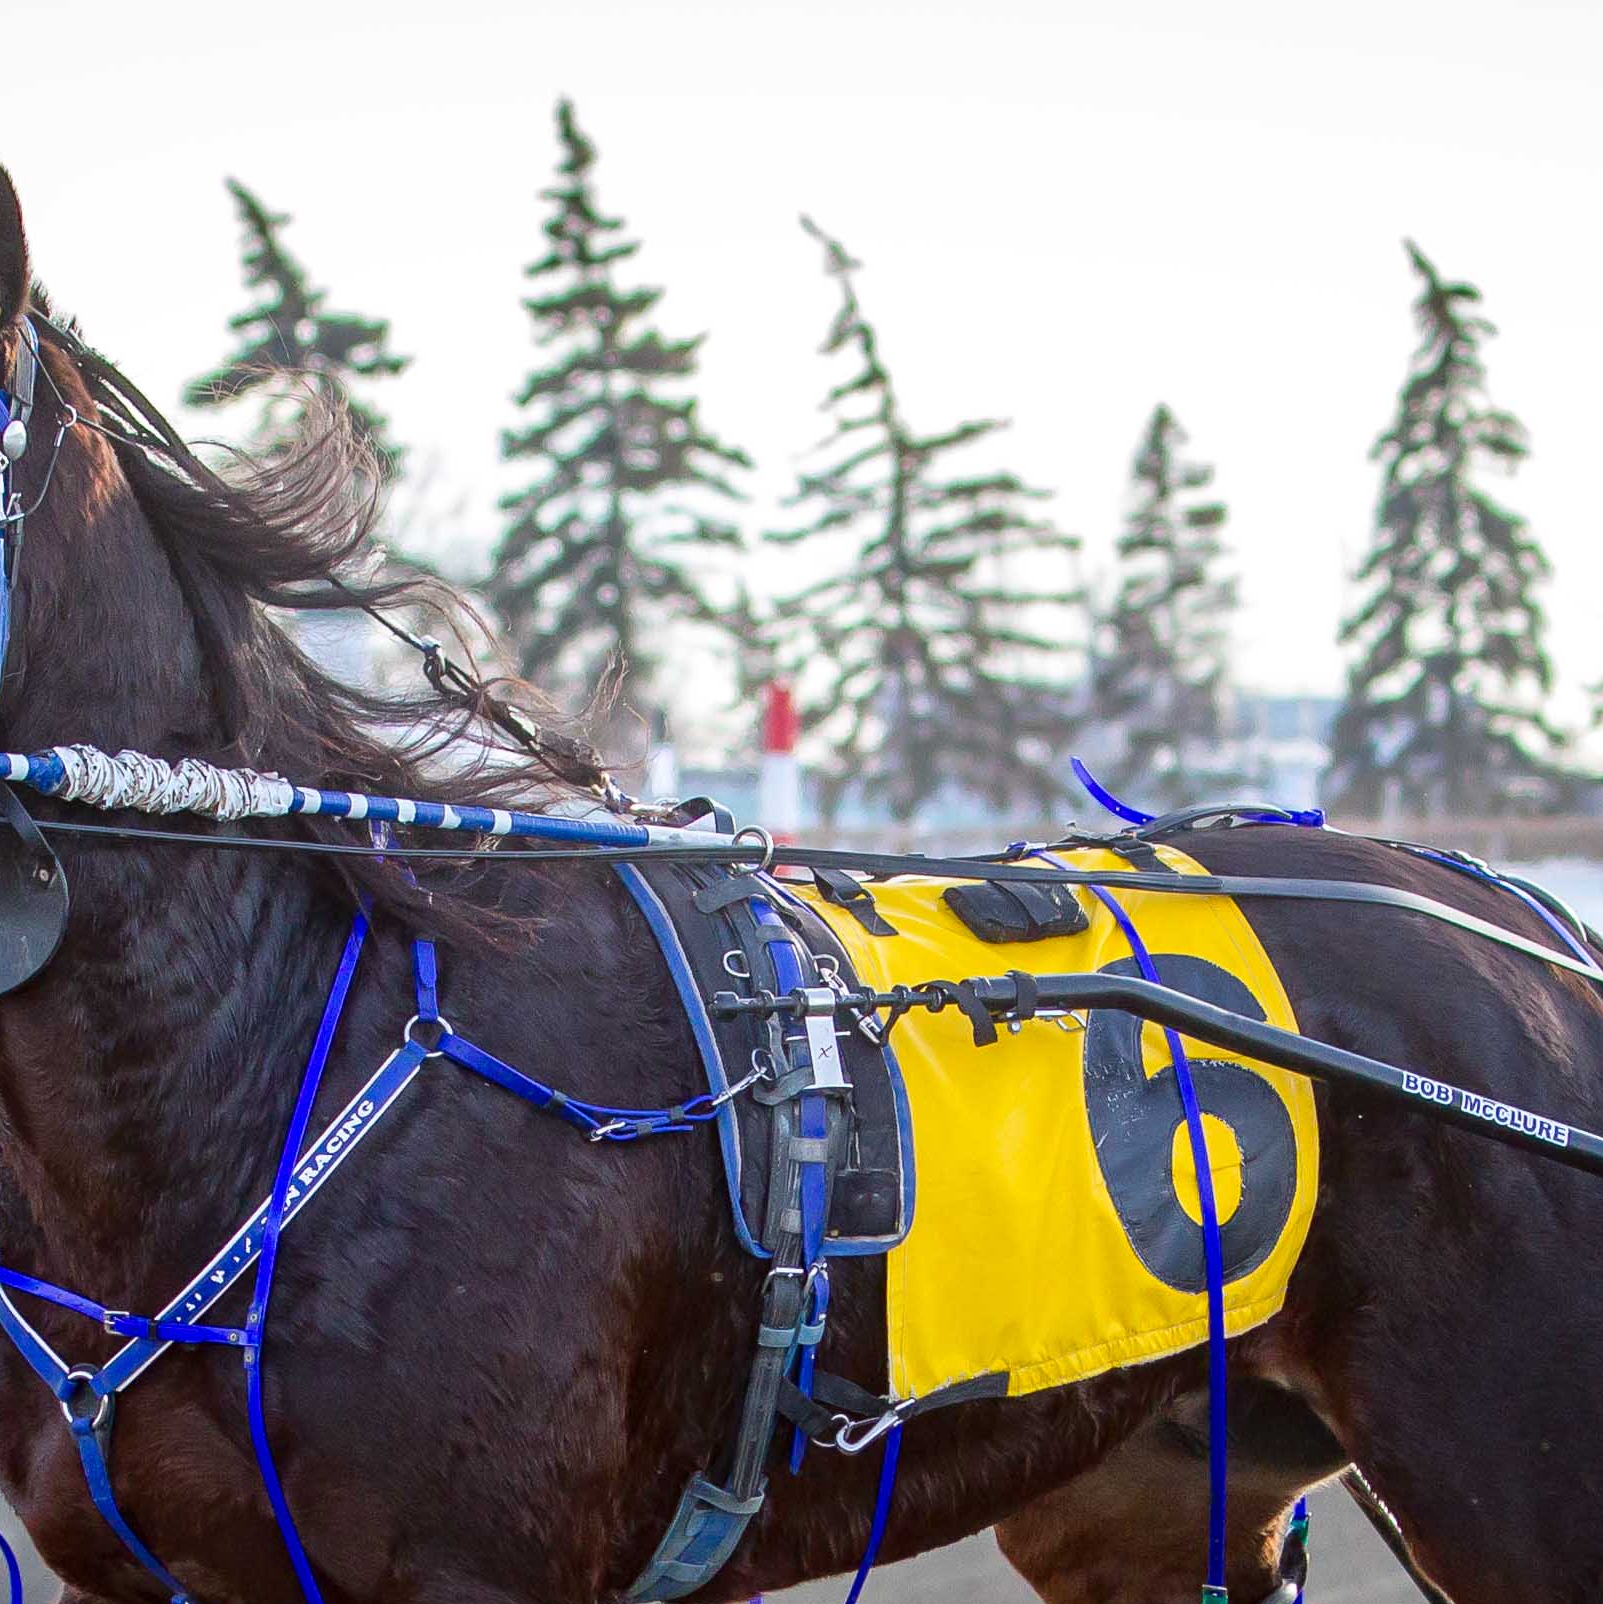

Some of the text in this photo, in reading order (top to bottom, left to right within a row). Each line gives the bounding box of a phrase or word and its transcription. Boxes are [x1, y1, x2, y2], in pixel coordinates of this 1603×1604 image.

[1083, 953, 1297, 1295] 6
[1404, 1073, 1452, 1104] BOB
[298, 1099, 375, 1187] RACING
